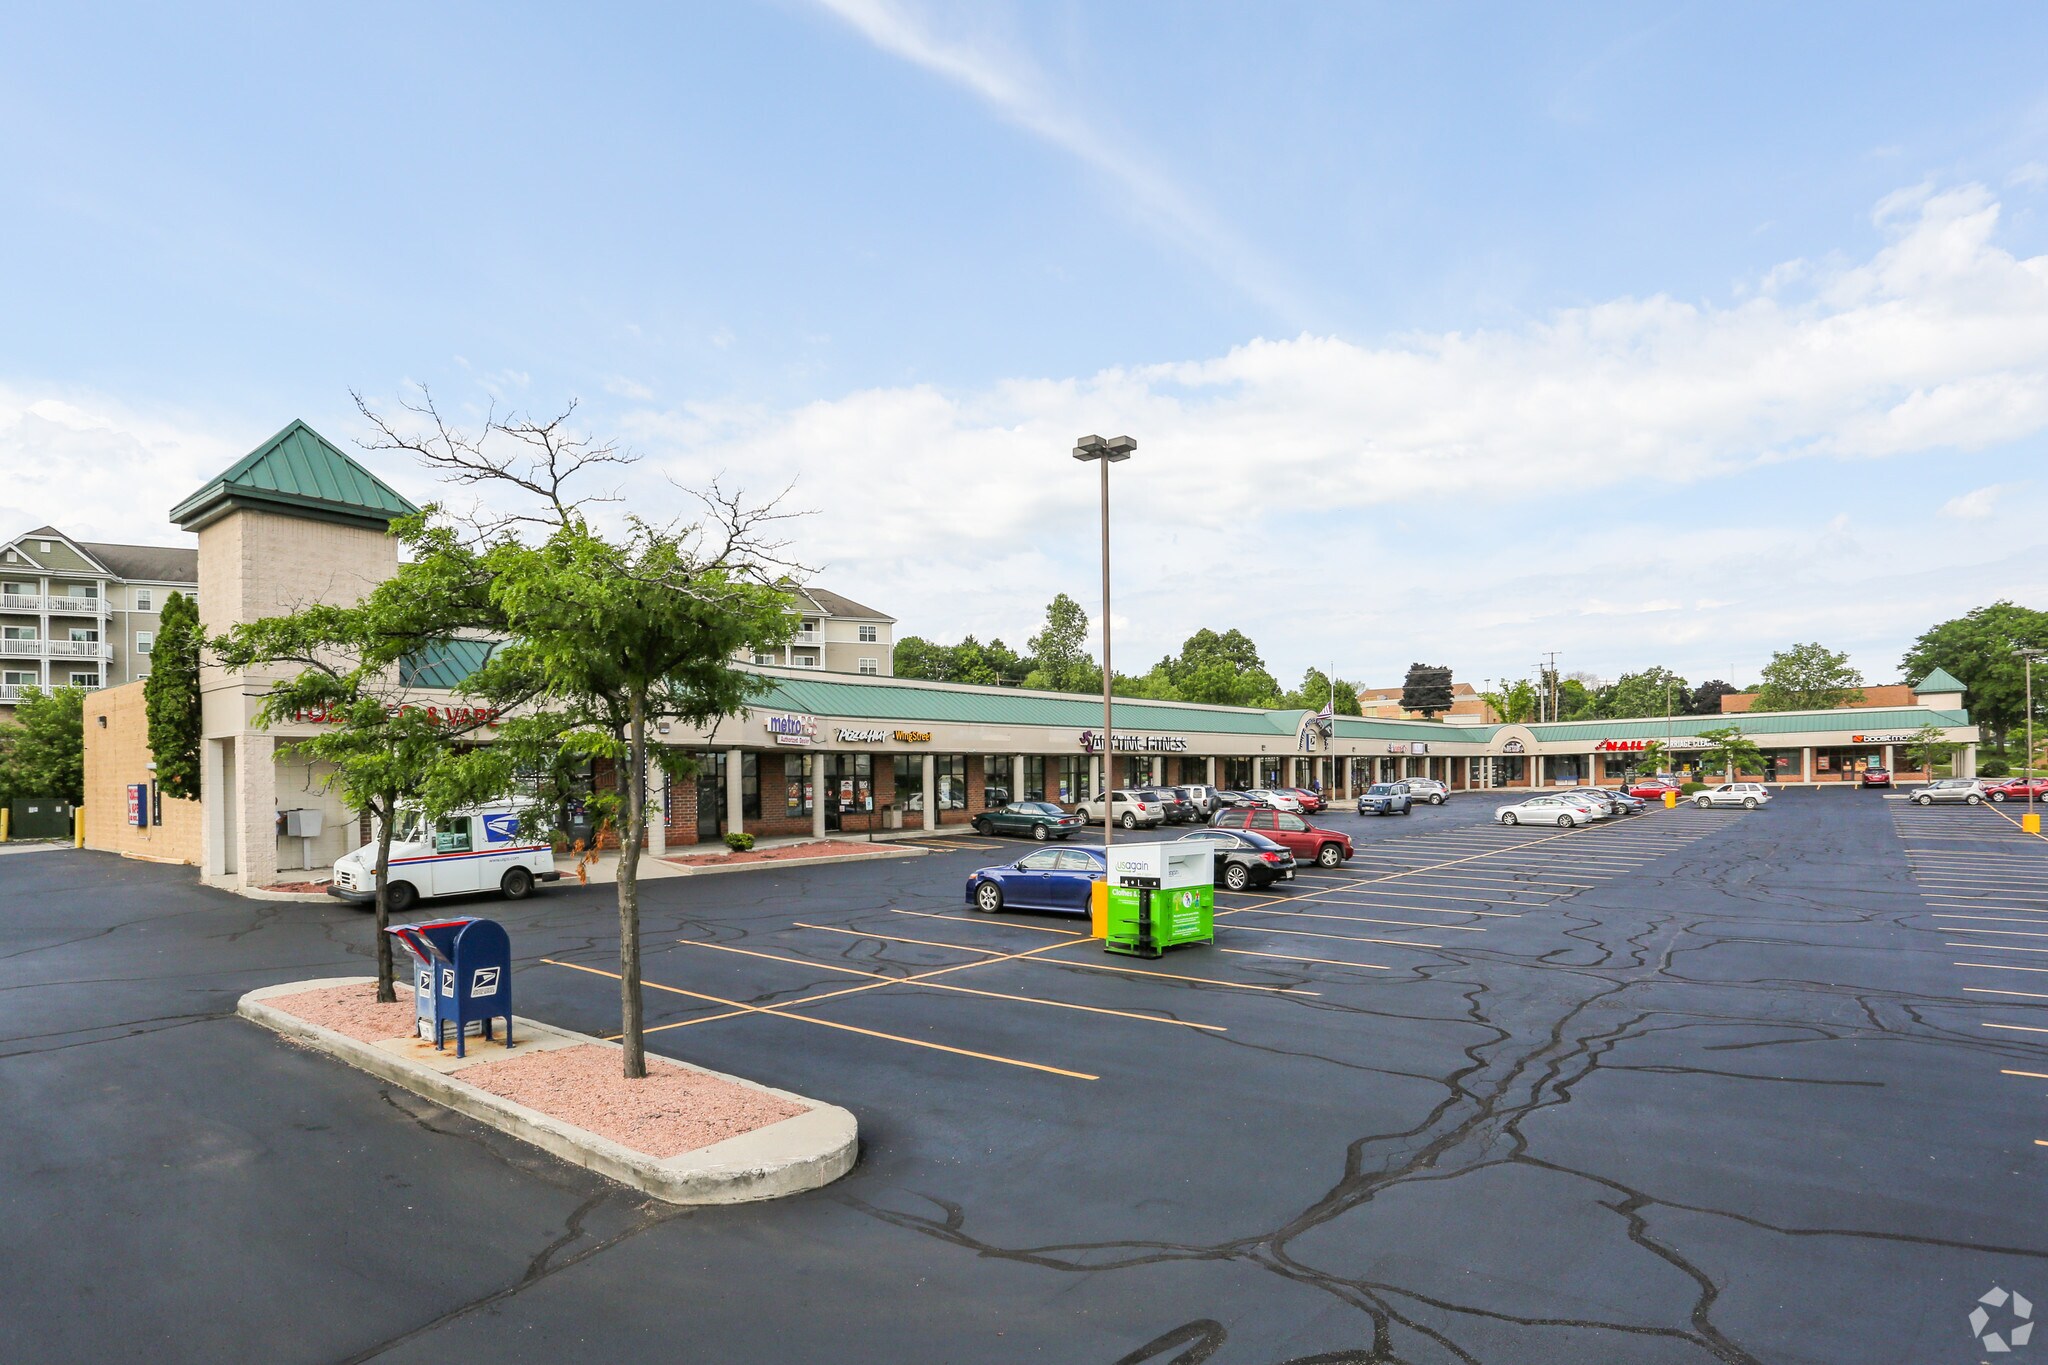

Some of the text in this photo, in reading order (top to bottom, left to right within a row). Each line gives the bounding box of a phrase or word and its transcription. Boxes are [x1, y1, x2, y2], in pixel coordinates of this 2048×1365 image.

[893, 730, 932, 742] WingStreet
[1863, 734, 1891, 743] boost
[1147, 736, 1188, 751] FITNESS
[1112, 889, 1132, 897] Clothes
